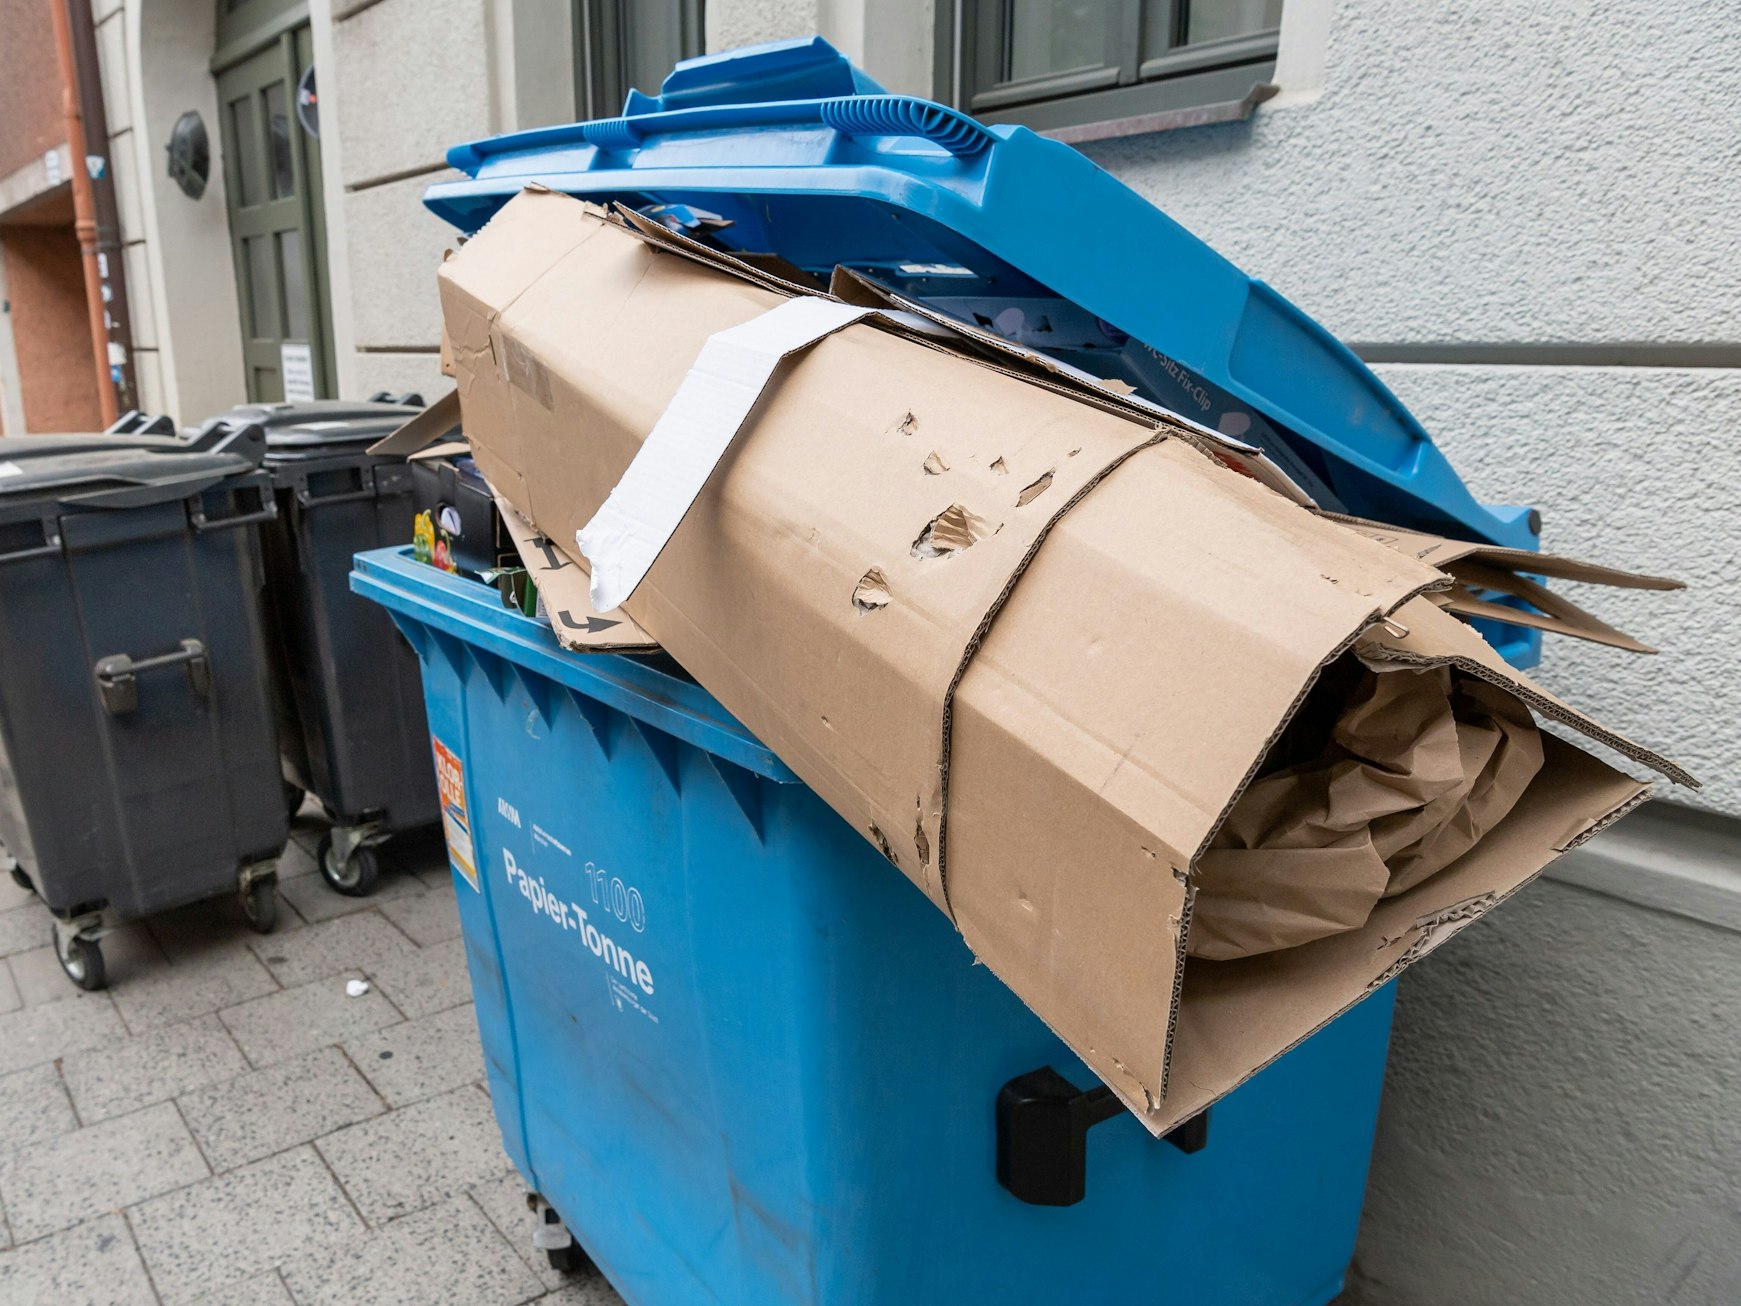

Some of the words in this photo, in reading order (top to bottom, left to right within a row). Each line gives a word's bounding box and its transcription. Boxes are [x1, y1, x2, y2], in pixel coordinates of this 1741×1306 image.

[1144, 343, 1179, 378] C-Sitz
[1176, 369, 1211, 411] Fix-Clip
[502, 846, 655, 995] Papier-Tonne
[585, 861, 645, 933] 1100
